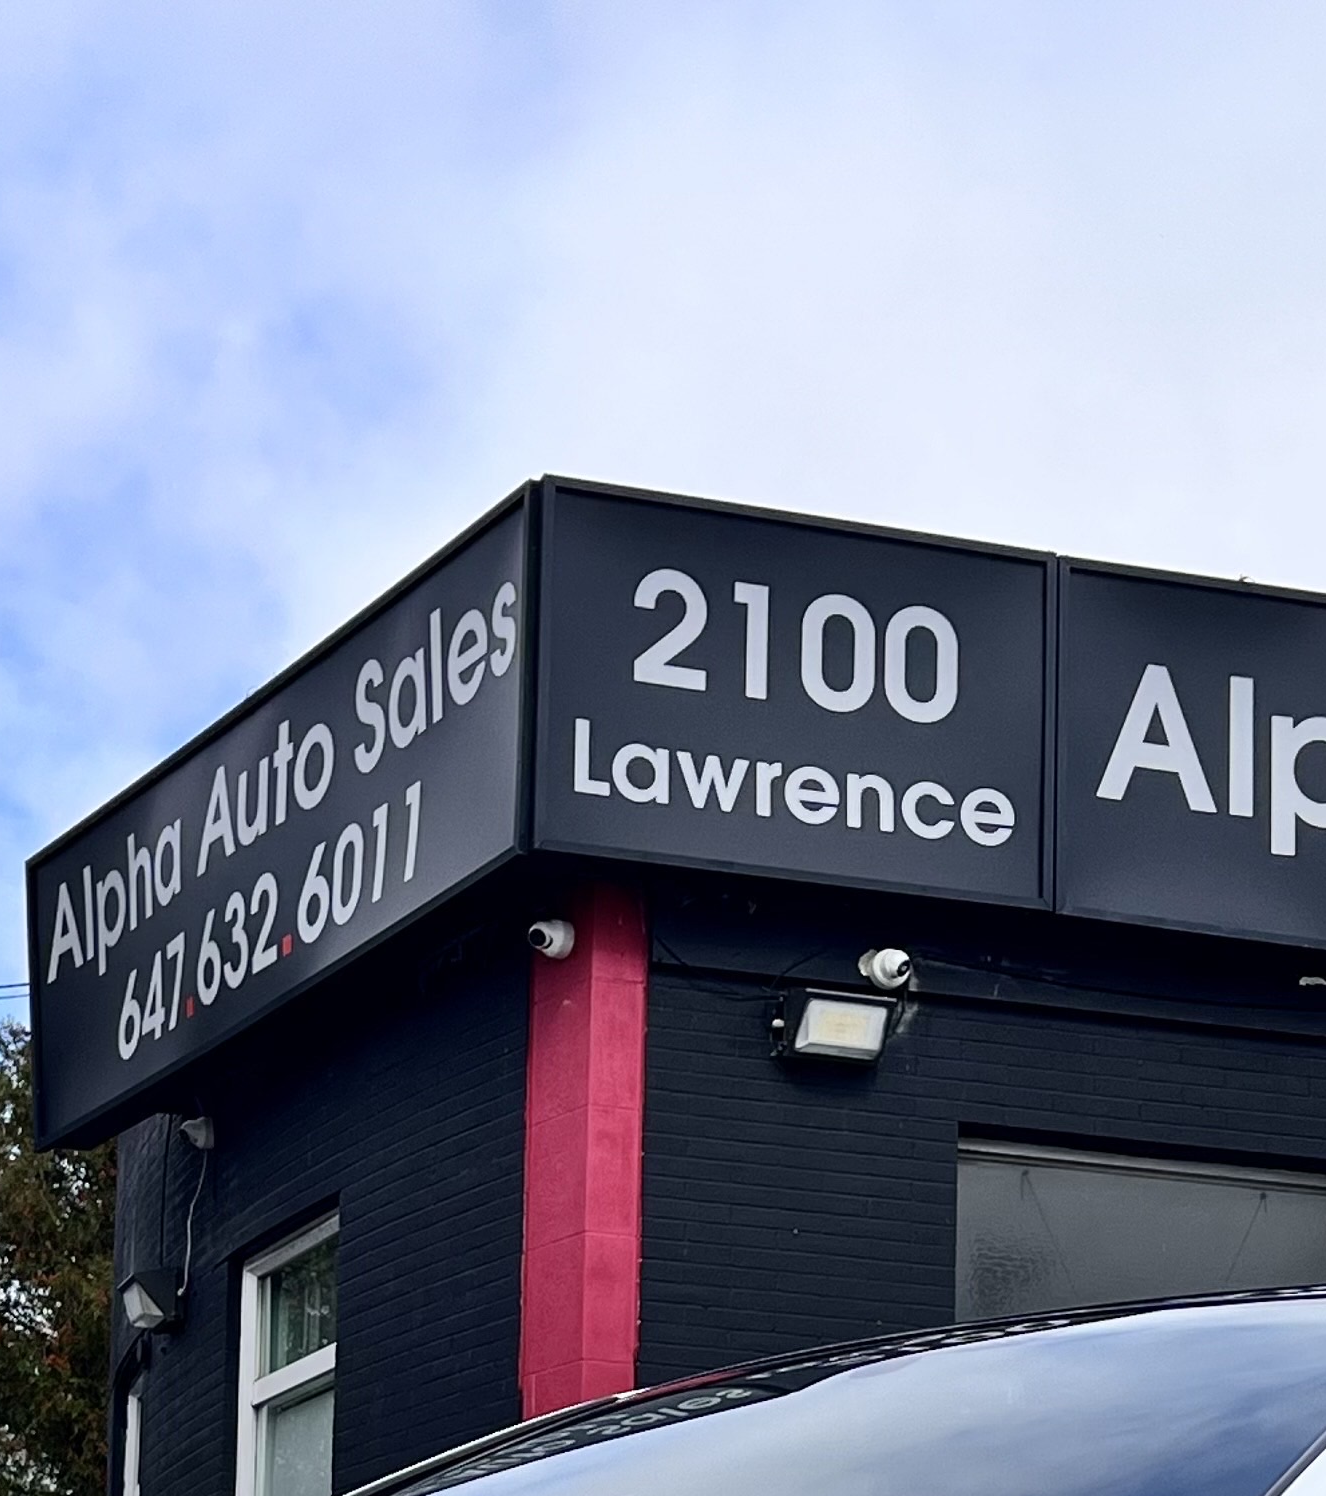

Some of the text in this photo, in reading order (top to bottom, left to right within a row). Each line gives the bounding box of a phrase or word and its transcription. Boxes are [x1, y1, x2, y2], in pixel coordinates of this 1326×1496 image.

[633, 568, 959, 724] 2100
[47, 581, 518, 984] Alpha Auto Sales
[573, 718, 1015, 847] Lawrence
[118, 780, 422, 1061] 647.632.6011
